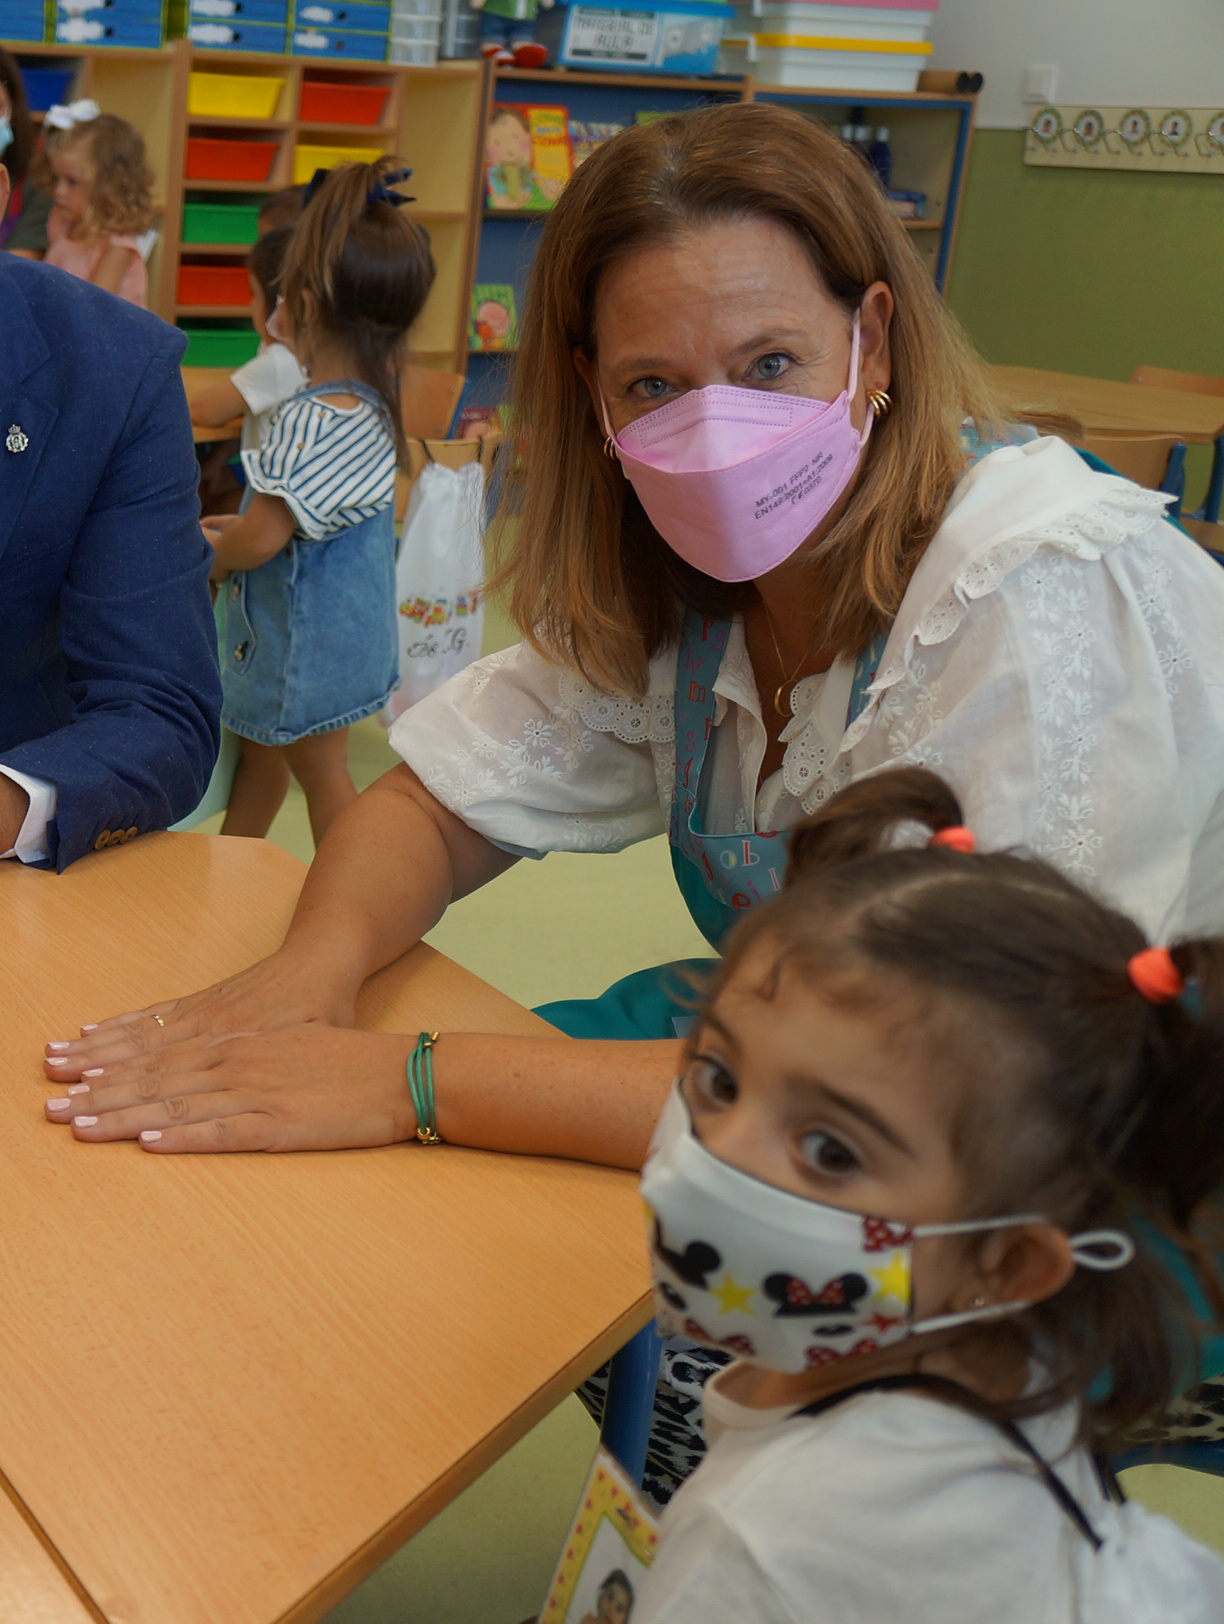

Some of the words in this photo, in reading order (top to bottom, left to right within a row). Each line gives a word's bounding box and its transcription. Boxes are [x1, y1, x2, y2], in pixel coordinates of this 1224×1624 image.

[755, 482, 788, 508] MY-001
[789, 464, 809, 485] FFP2
[811, 451, 824, 466] NR
